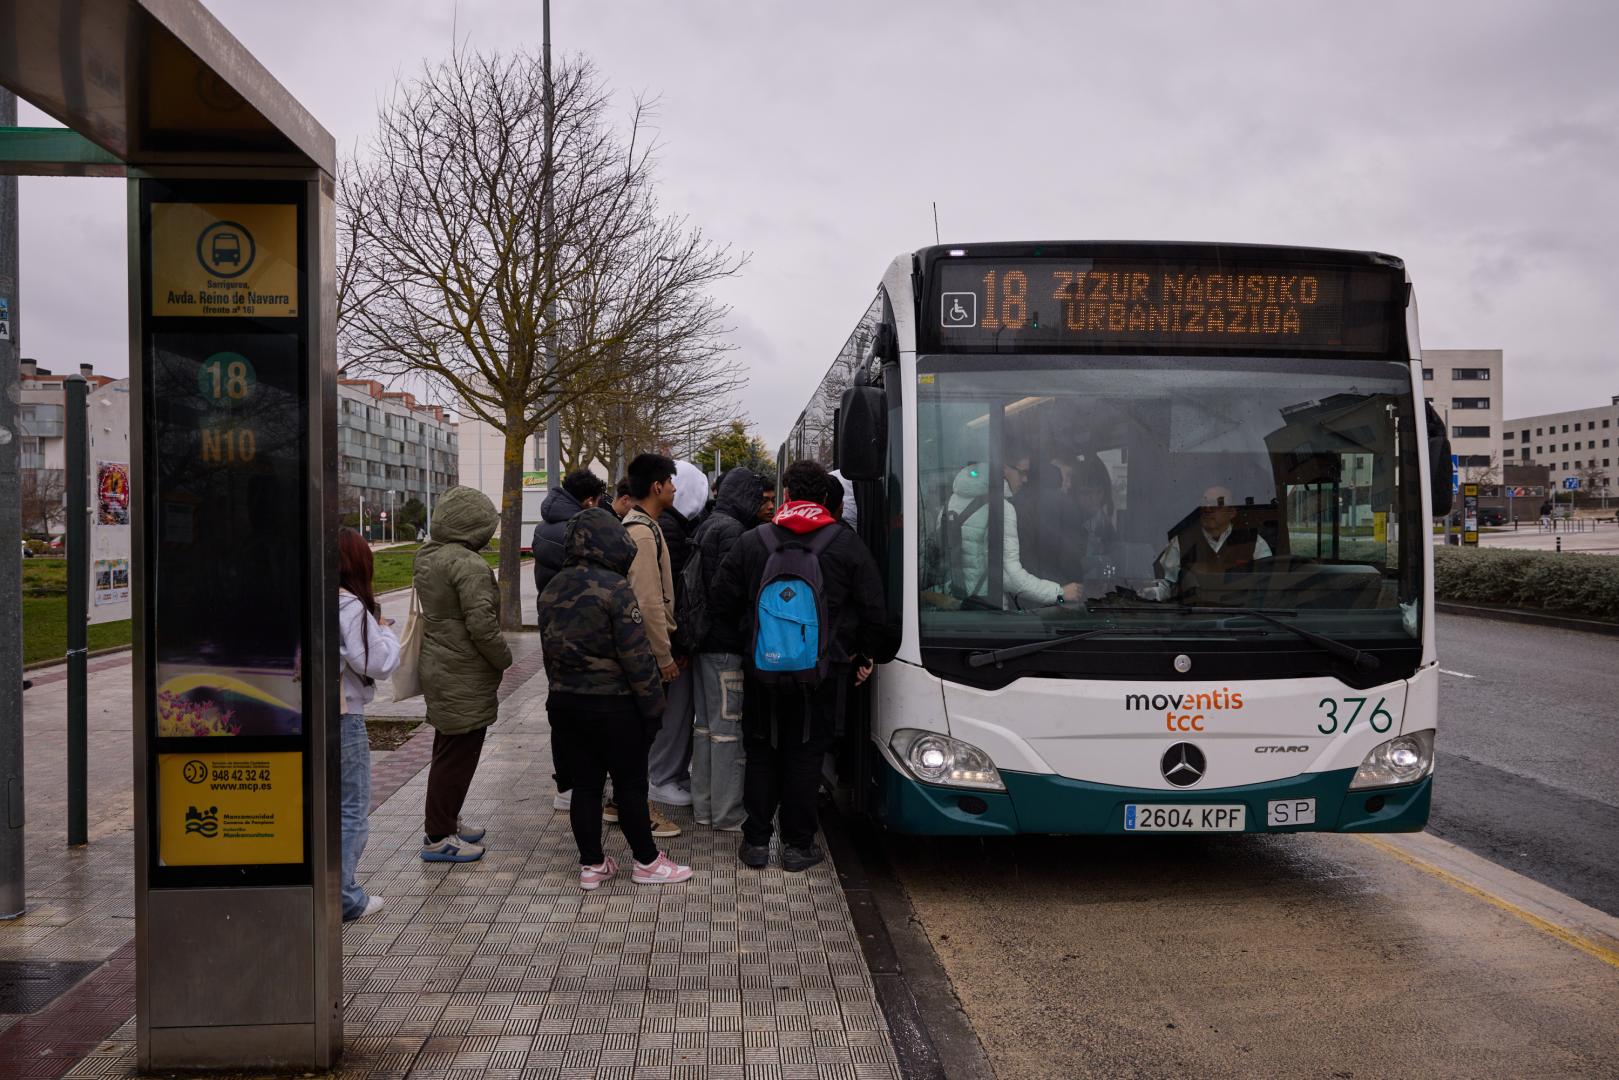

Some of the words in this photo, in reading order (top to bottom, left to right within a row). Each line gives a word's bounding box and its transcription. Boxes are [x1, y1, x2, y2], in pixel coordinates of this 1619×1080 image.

[168, 291, 196, 304] Avda.
[200, 291, 229, 304] Reino
[232, 291, 245, 304] de
[248, 291, 289, 304] Navarra
[1052, 271, 1150, 301] ZIZUR
[1163, 273, 1319, 304] NAGUSIKO
[980, 269, 1028, 331] 18
[1065, 300, 1301, 334] URBANIZAZIOA
[207, 361, 248, 400] 18
[202, 429, 256, 463] N10
[1125, 687, 1243, 711] moventis
[1166, 712, 1204, 731] tcc
[1317, 697, 1392, 734] 376
[1255, 745, 1309, 753] CITARO
[210, 782, 272, 792] www.mcp.es
[211, 769, 229, 781] 948
[232, 769, 242, 781] 42
[245, 769, 256, 781] 32
[259, 769, 270, 781] 42
[1140, 808, 1194, 828] 2604
[1201, 808, 1241, 828] KPF
